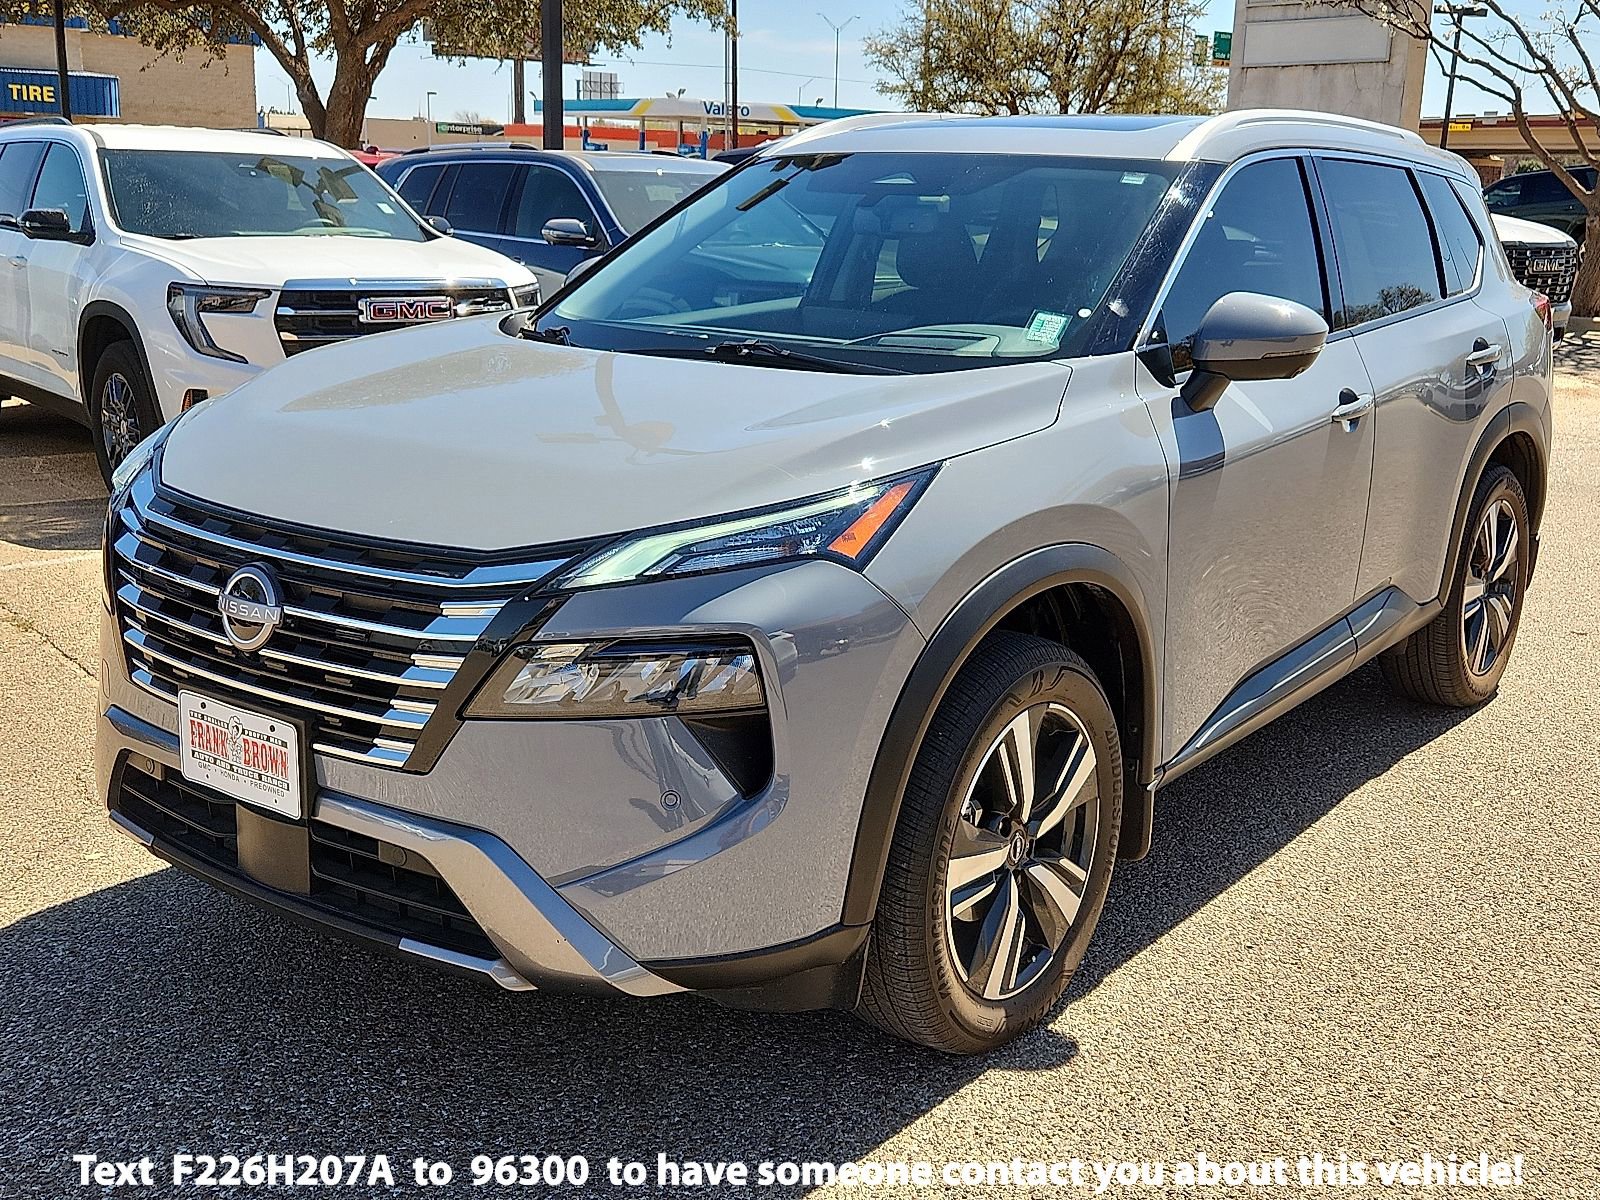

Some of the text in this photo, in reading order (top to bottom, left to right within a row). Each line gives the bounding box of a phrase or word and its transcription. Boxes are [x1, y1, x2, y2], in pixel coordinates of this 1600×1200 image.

[8, 83, 56, 103] TIRE
[1533, 258, 1565, 272] GMC
[370, 301, 450, 320] GMC
[219, 595, 278, 621] NISSAN
[189, 719, 288, 780] FRANK BROWN
[193, 751, 288, 790] AUTO AND TRUCK RANCH
[197, 761, 285, 798] GMC HONDA PREOWNED
